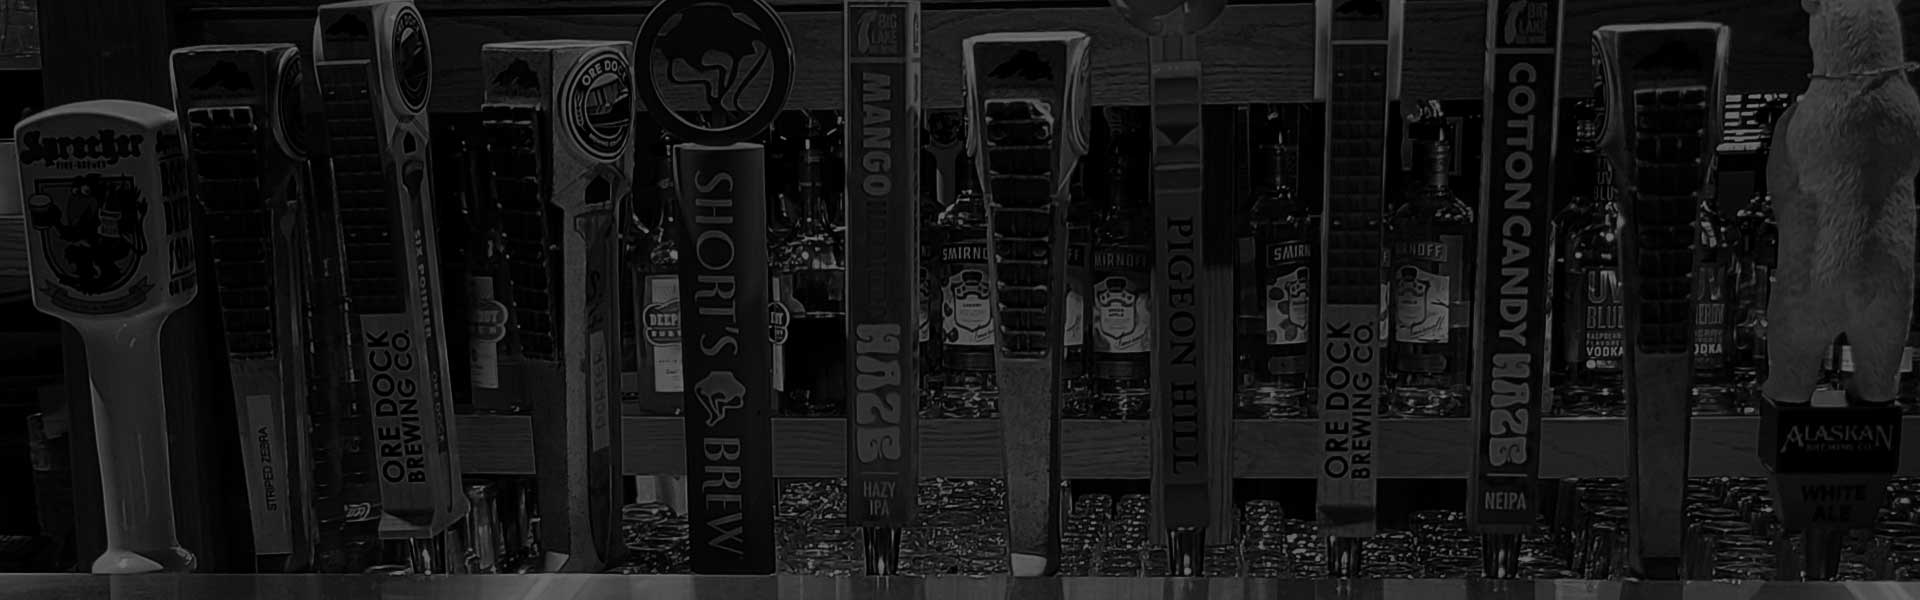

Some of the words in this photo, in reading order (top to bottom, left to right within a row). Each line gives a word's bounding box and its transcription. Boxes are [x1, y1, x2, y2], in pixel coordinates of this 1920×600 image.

[581, 62, 603, 87] ORE
[860, 71, 892, 197] MANGO
[1594, 184, 1618, 201] BLU
[694, 168, 740, 357] SHORT'S
[942, 245, 988, 262] SMIRNO
[1273, 243, 1311, 261] SMIRN
[1167, 216, 1196, 368] PIGEON
[649, 312, 678, 327] DEEP
[394, 329, 413, 372] CO.
[1352, 322, 1374, 364] CO.
[1586, 346, 1624, 357] VODKA
[1694, 343, 1723, 355] DKA
[365, 331, 399, 418] DOCK
[1325, 322, 1350, 411] DOCK
[856, 323, 901, 463] HAZE
[1488, 352, 1532, 467] HAZE
[397, 378, 426, 483] BREWING
[1171, 381, 1199, 475] HILL
[1350, 372, 1373, 480] BREWING
[1780, 424, 1895, 453] ALASKAN
[377, 425, 405, 484] ORE
[1324, 421, 1349, 479] ORE
[702, 437, 744, 560] BREW
[863, 480, 896, 498] HAZY
[869, 500, 890, 516] IPA
[1484, 491, 1527, 511] NEIPA
[1801, 485, 1867, 502] WHITE
[1812, 506, 1851, 521] ALE
